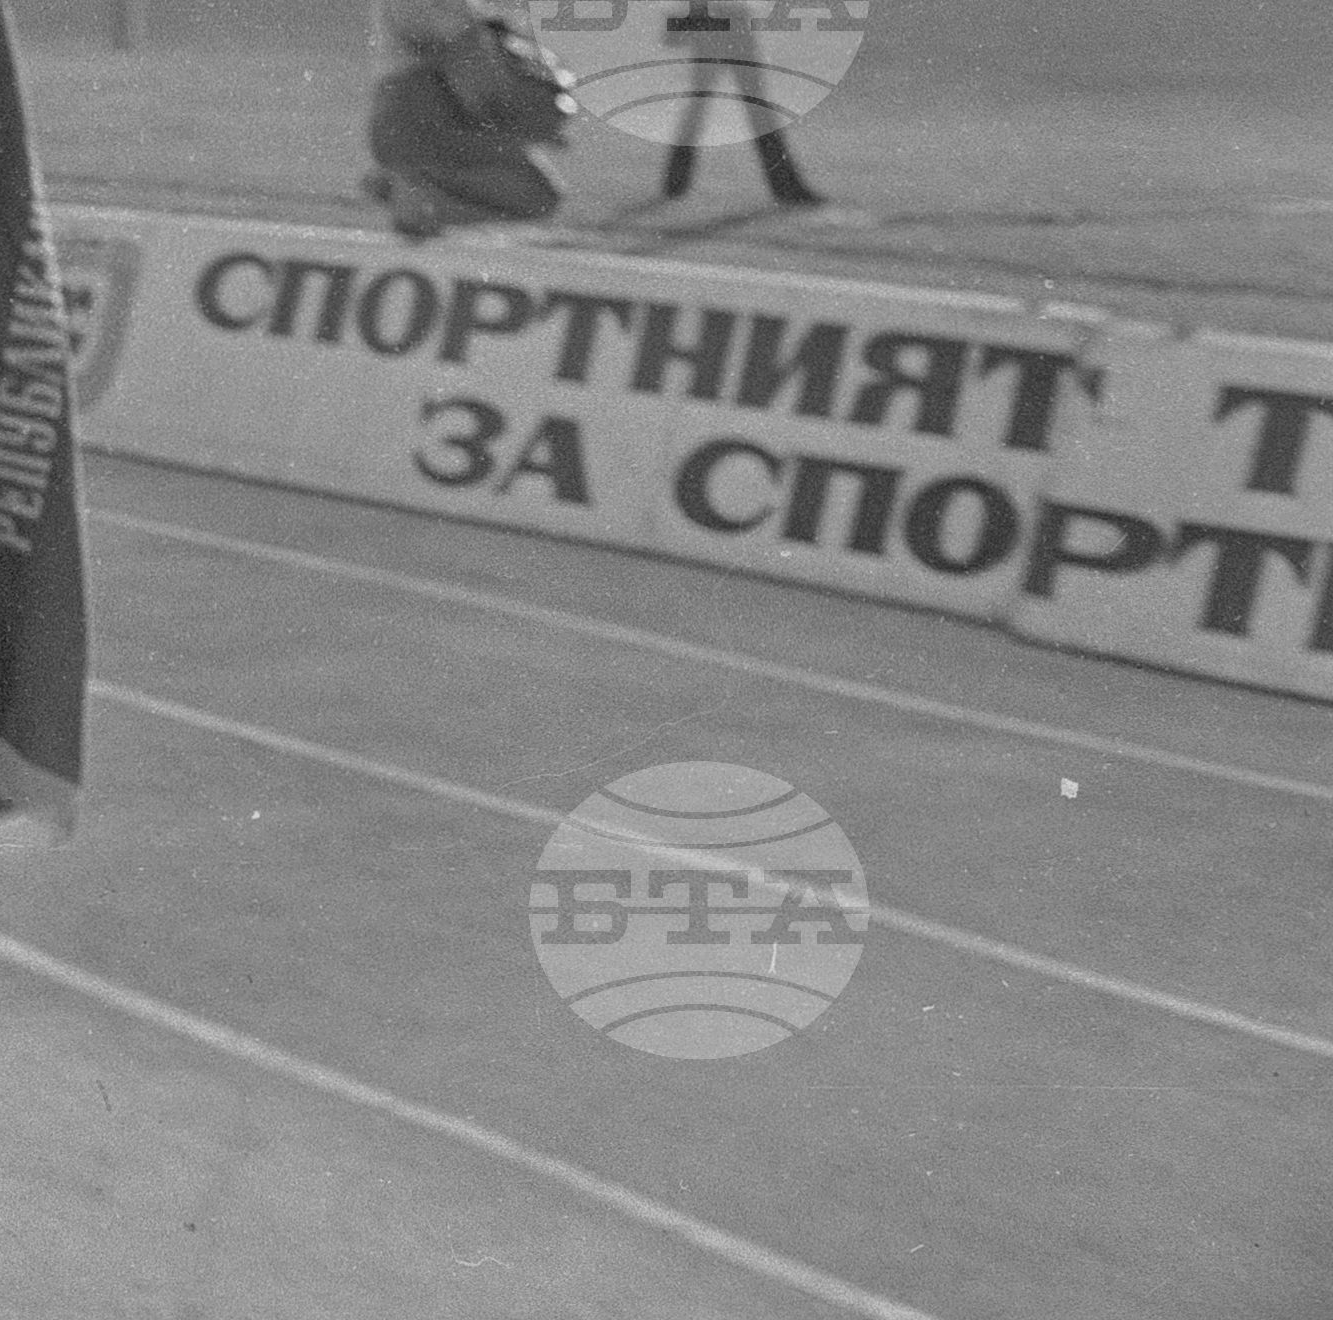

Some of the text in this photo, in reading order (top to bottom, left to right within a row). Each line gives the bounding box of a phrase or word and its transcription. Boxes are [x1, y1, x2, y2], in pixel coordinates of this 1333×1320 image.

[195, 251, 1105, 453] СПОРТНИЯТ
[410, 394, 1333, 657] ЗА СПОРТ
